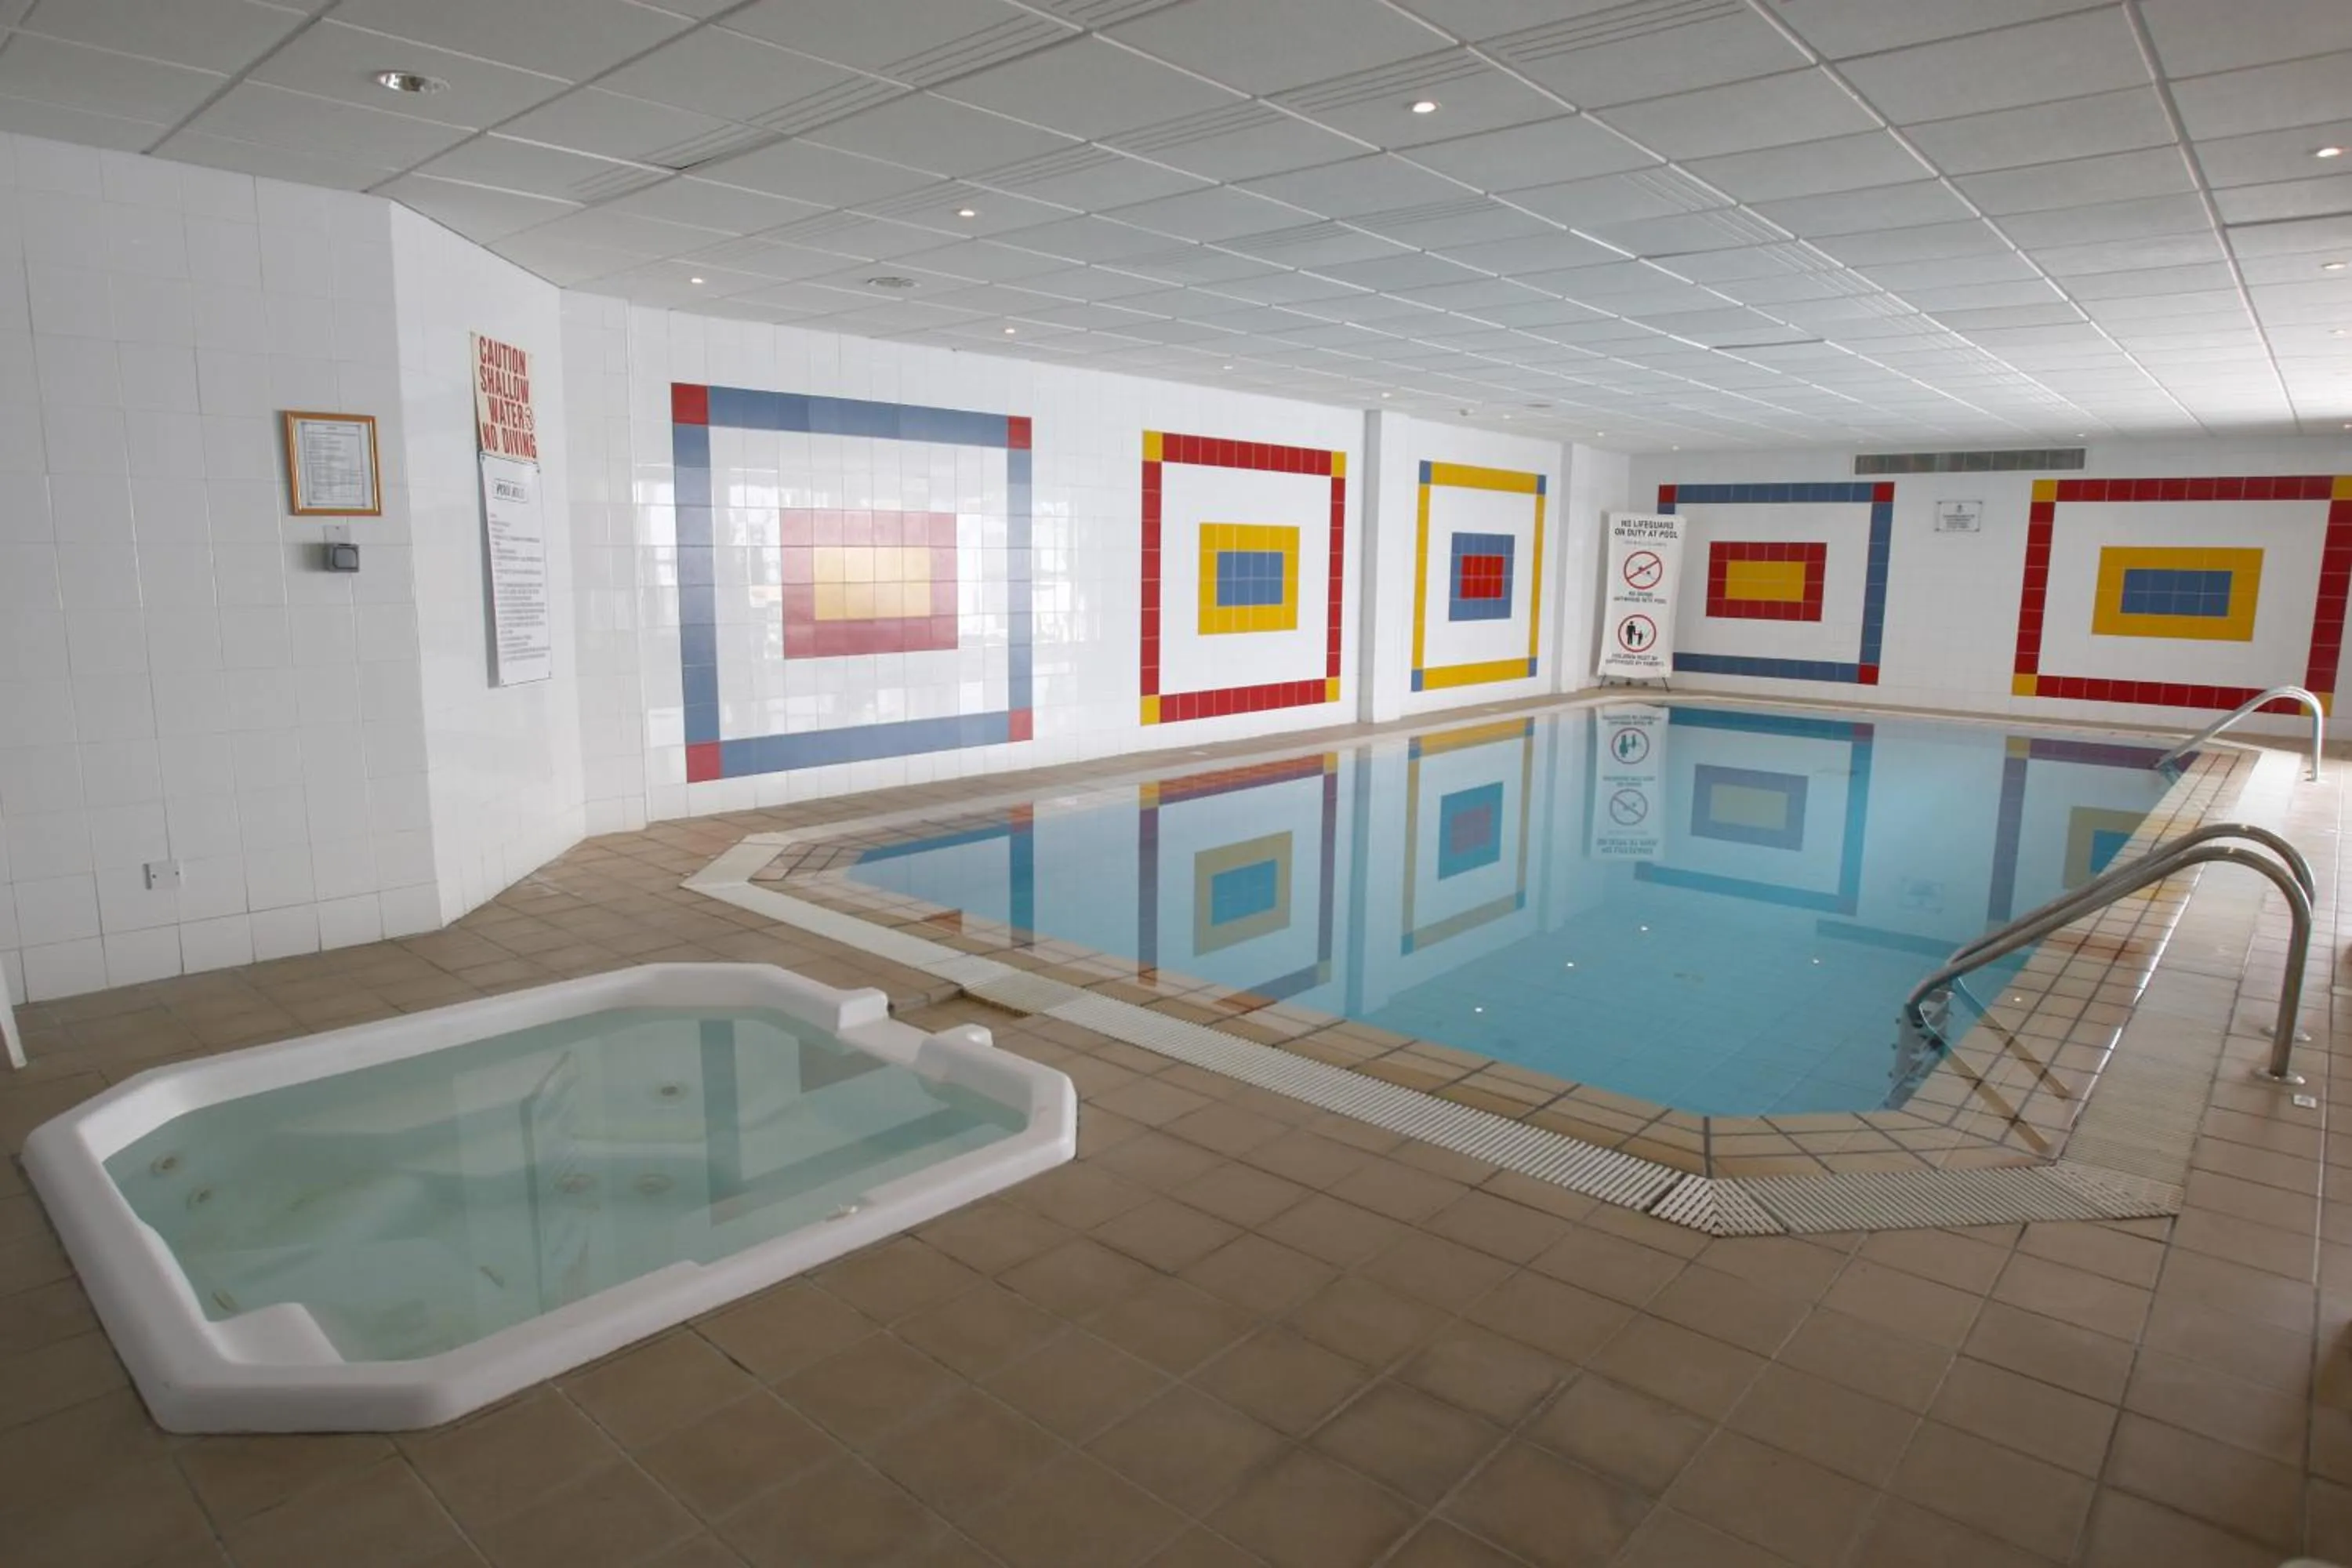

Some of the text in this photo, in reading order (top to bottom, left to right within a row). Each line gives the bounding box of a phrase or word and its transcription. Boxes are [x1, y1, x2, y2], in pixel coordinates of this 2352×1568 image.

[478, 336, 527, 377] CAUTION
[479, 364, 530, 404] SHALLOW
[488, 395, 525, 429] WATER
[482, 421, 538, 459] NO DIVING
[1614, 528, 1625, 536] ON
[1627, 528, 1647, 537] DUTY
[1658, 529, 1678, 539] POOL
